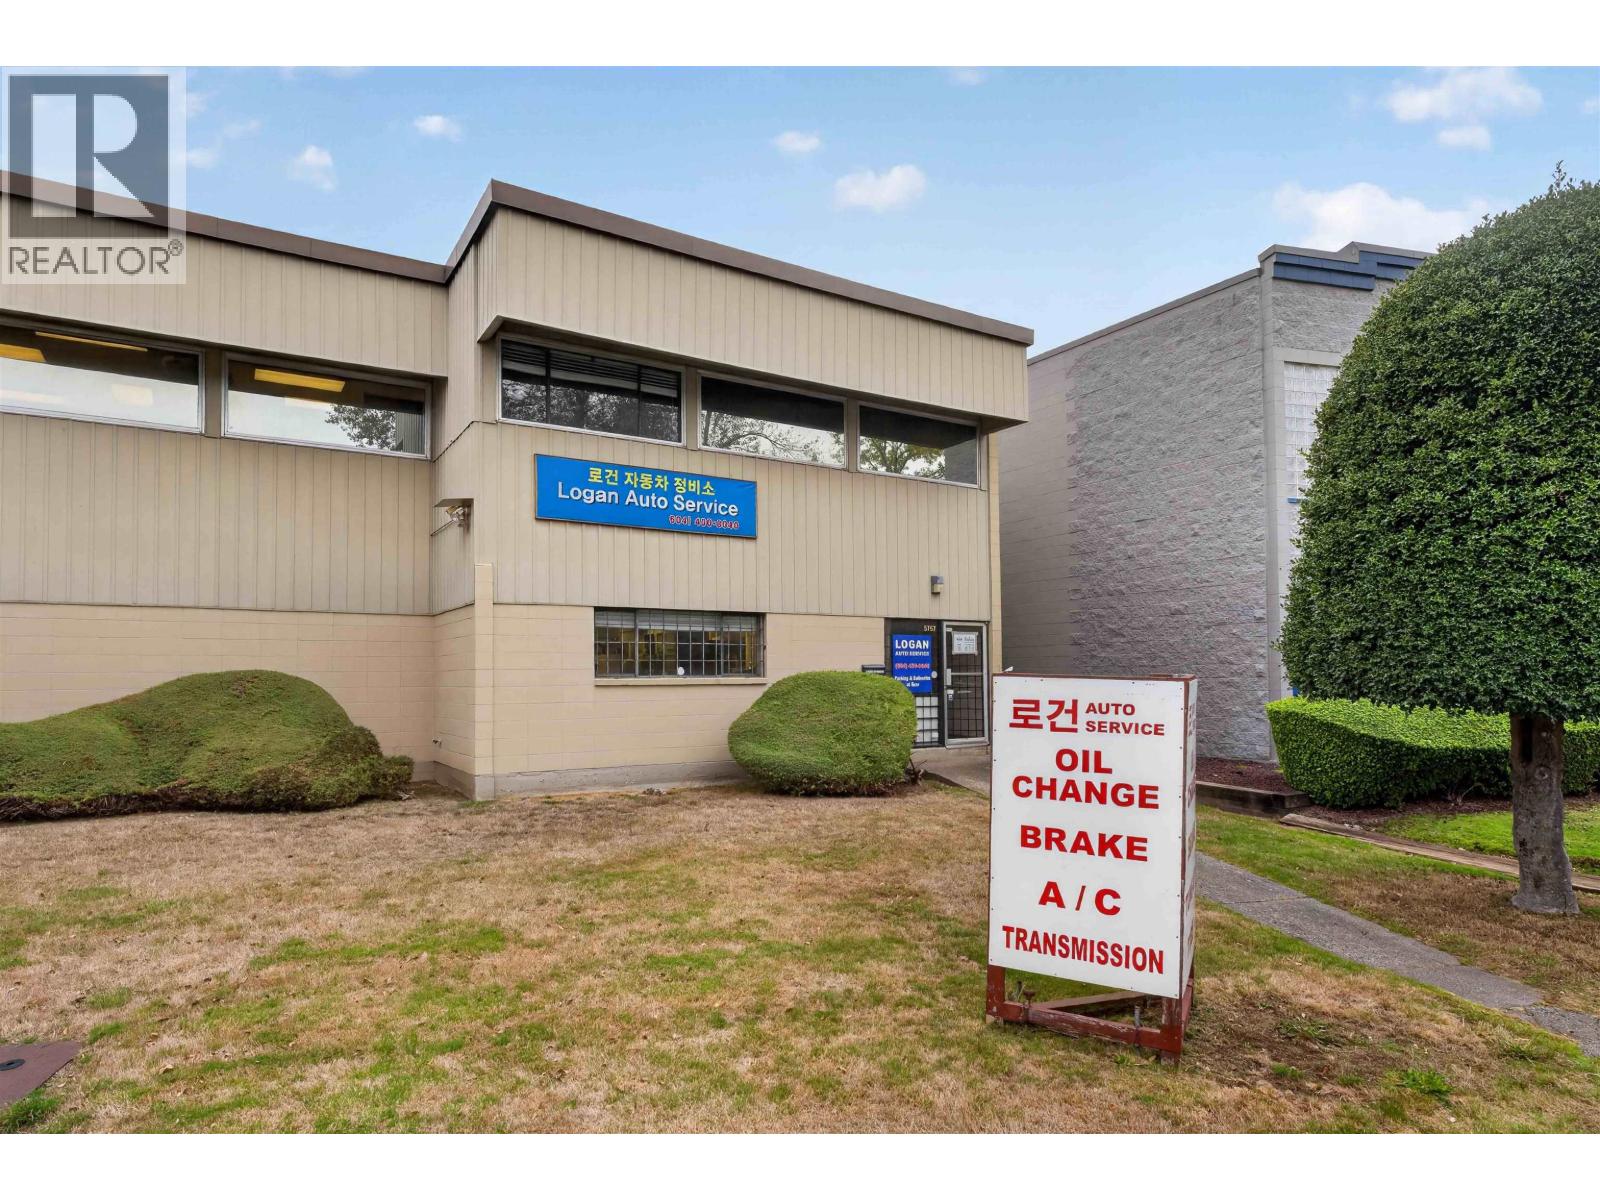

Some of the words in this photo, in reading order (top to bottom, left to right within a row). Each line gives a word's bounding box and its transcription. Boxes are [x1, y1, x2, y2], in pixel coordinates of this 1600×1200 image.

[588, 467, 619, 485] 로건
[624, 472, 668, 491] 자동차
[673, 477, 715, 496] 정비소
[557, 482, 619, 505] Logan
[625, 489, 668, 510] Auto
[673, 496, 739, 517] Service
[895, 640, 929, 649] LOGAN
[1009, 699, 1078, 733] 로건
[1085, 702, 1135, 716] AUTO
[1086, 720, 1165, 736] SERVICE
[1055, 748, 1113, 774] OIL
[1012, 775, 1159, 809] CHANGE
[1020, 824, 1148, 862] BRAKE
[1002, 925, 1164, 974] TRANSMISSION
